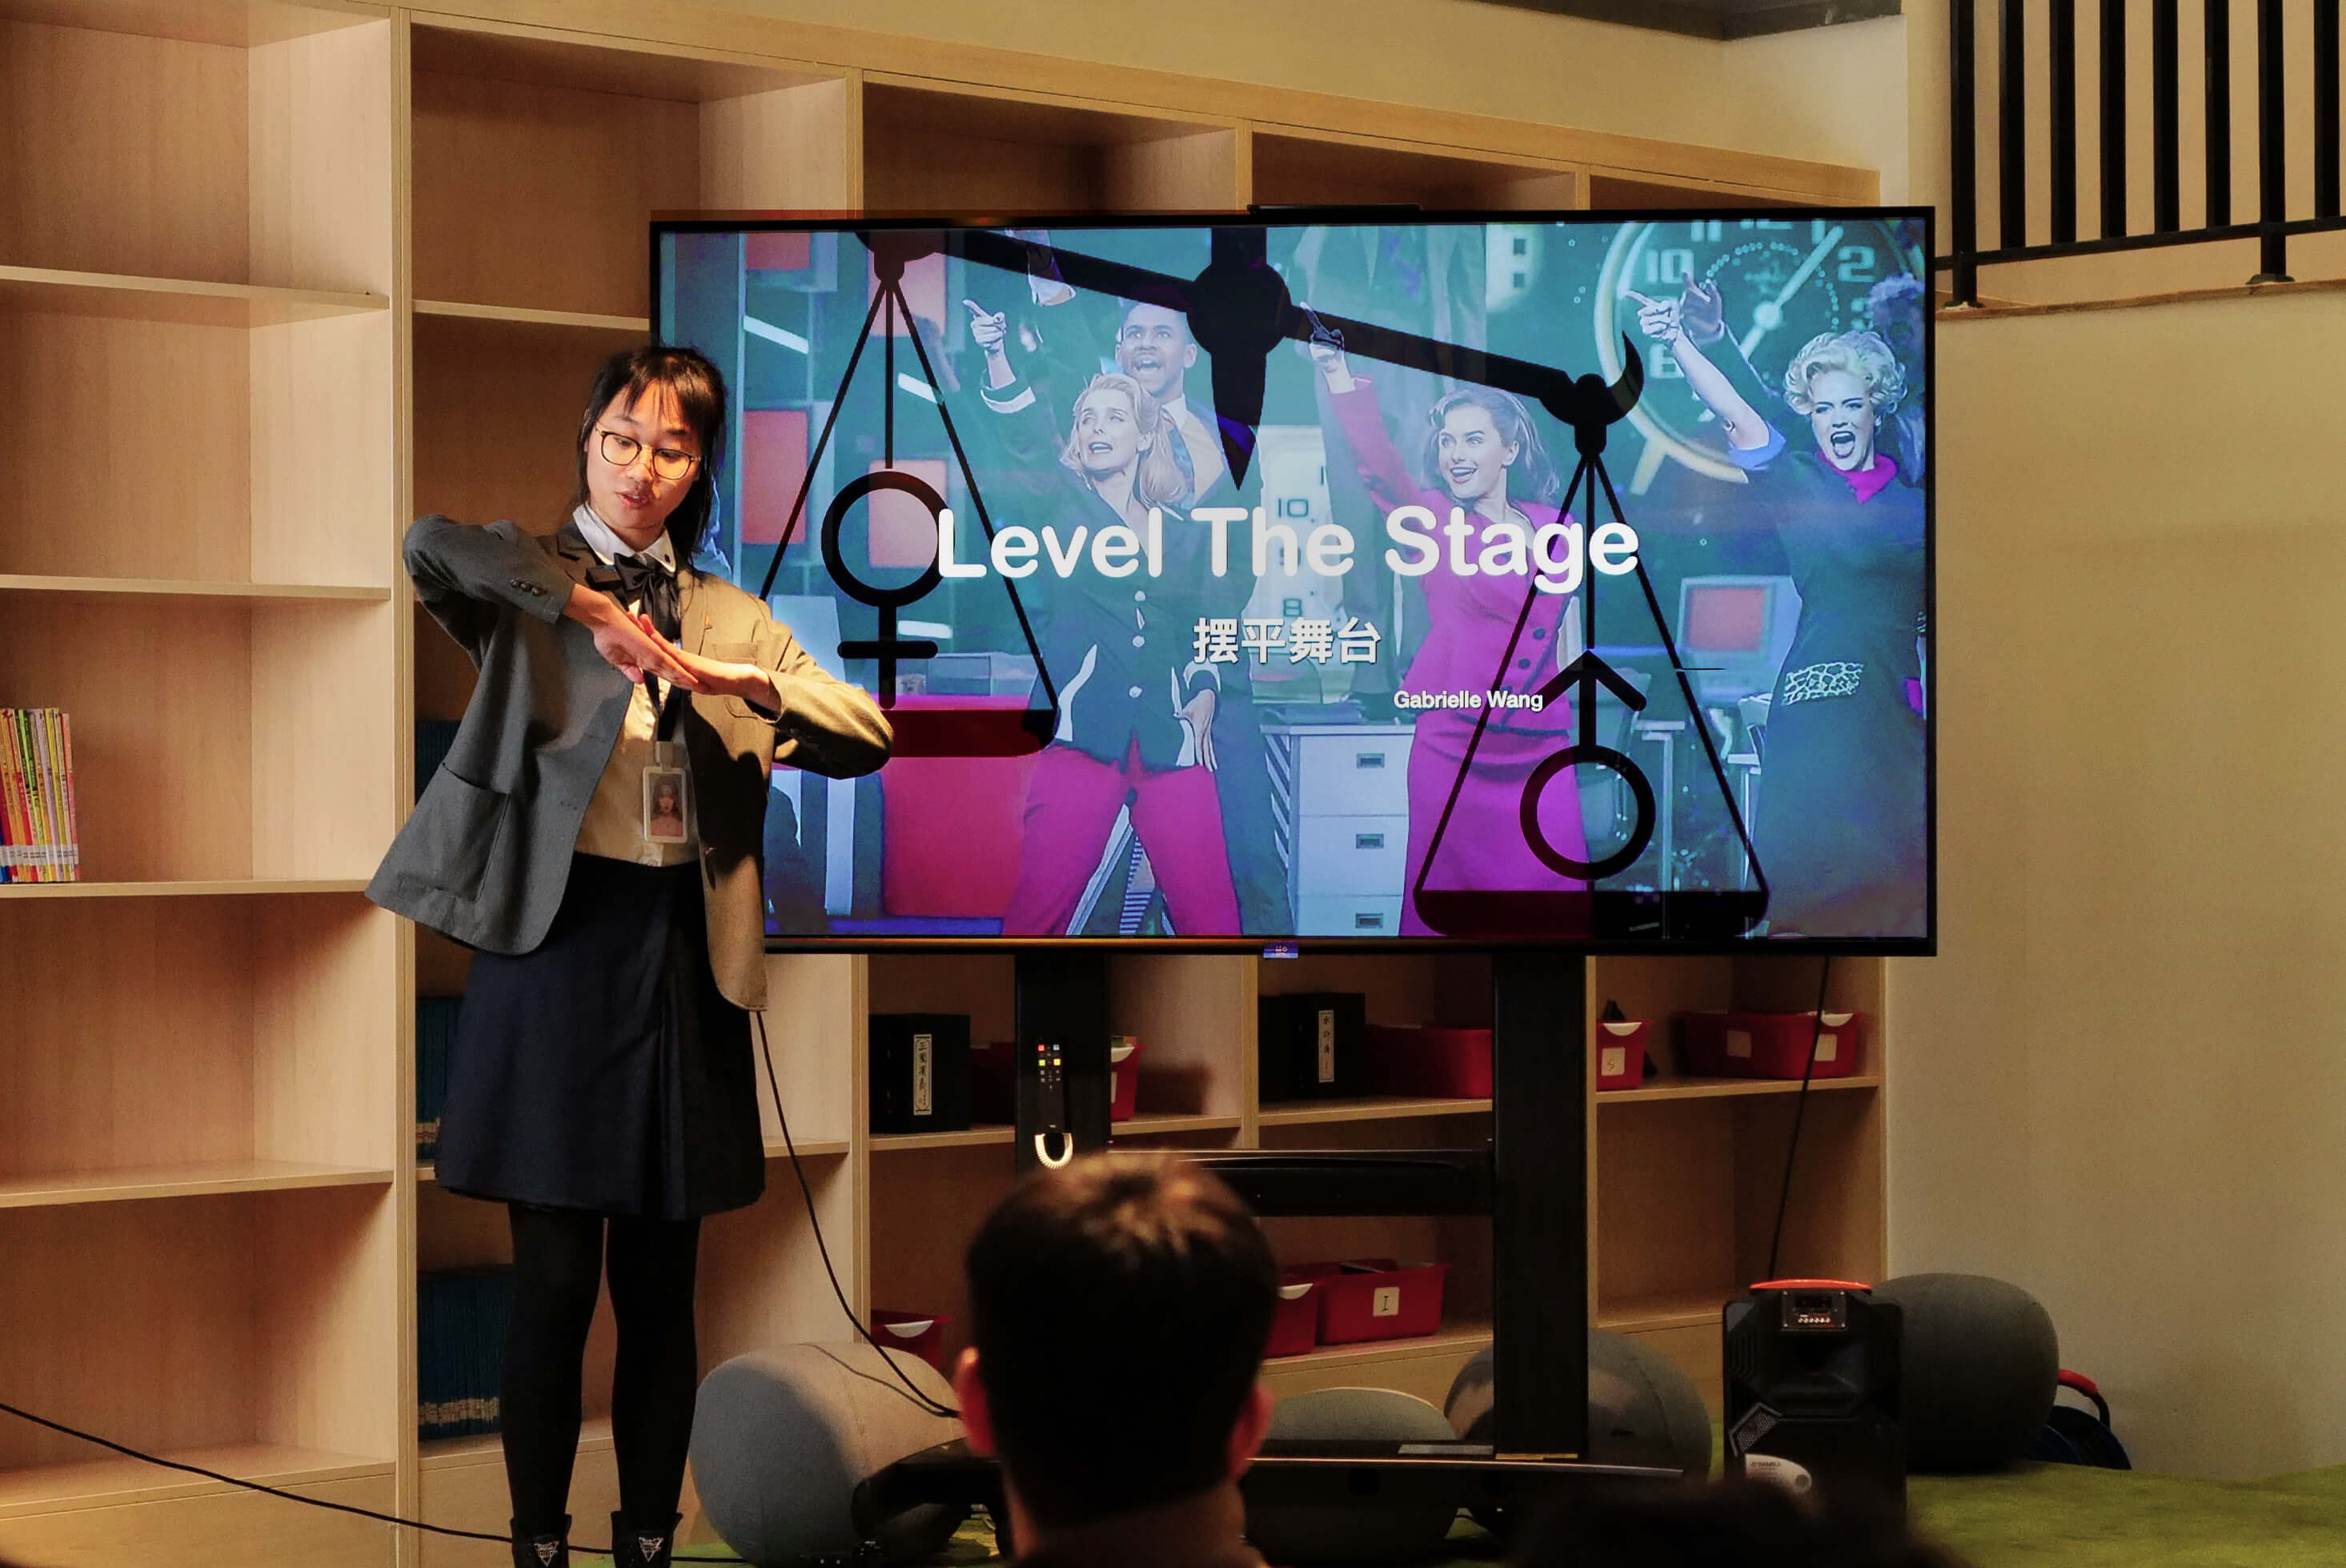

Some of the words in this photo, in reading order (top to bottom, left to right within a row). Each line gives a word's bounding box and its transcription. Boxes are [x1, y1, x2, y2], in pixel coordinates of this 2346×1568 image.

[1646, 248, 1694, 284] 10
[1838, 246, 1875, 283] 2
[1277, 498, 1309, 518] 10
[938, 506, 1163, 578] Level
[1190, 505, 1355, 578] The
[1385, 505, 1639, 595] Stage
[1192, 616, 1382, 664] 摆平舞台
[1393, 690, 1482, 710] Gabrielle
[1486, 690, 1544, 712] Wang
